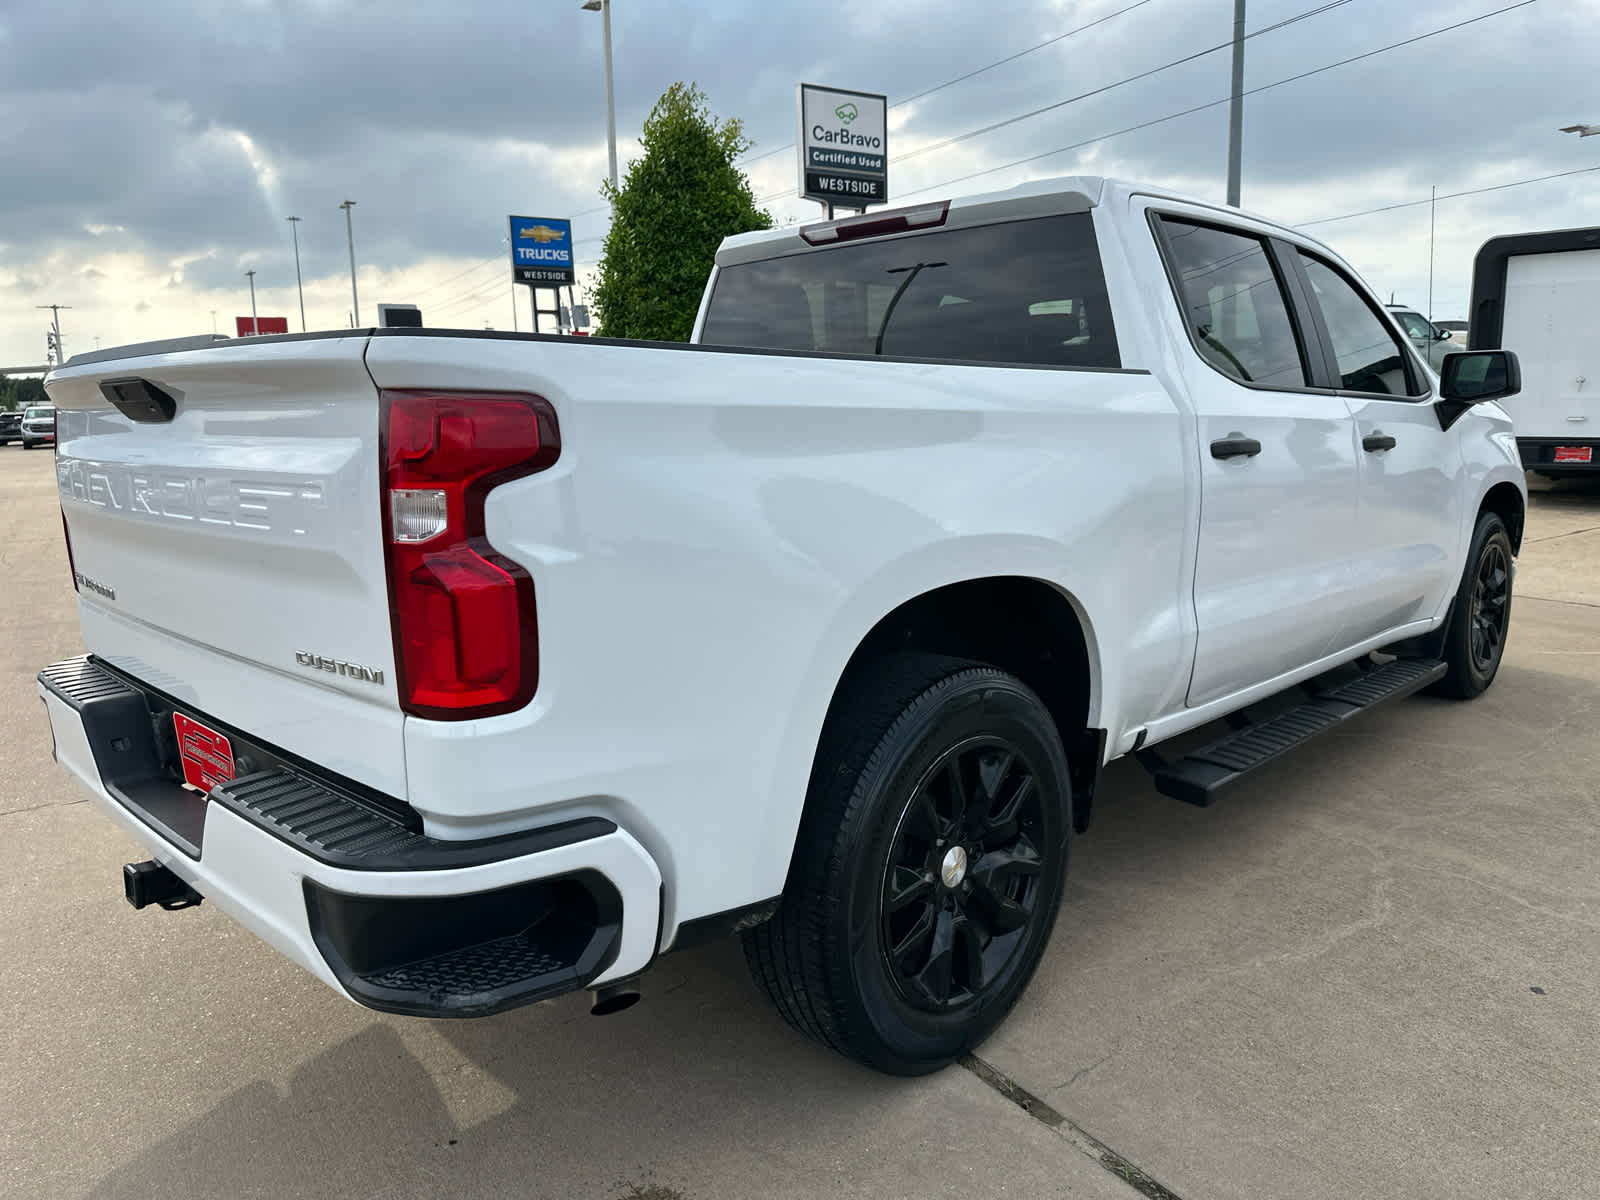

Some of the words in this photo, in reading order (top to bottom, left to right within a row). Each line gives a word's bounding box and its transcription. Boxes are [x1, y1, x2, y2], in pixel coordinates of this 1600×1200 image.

[812, 125, 880, 148] CarBravo
[813, 151, 856, 165] Certified
[858, 157, 881, 167] Used
[819, 176, 877, 194] WESTSIDE
[517, 247, 569, 261] TRUCKS
[523, 271, 566, 280] WESTSIDE
[296, 650, 384, 685] CUSTOM
